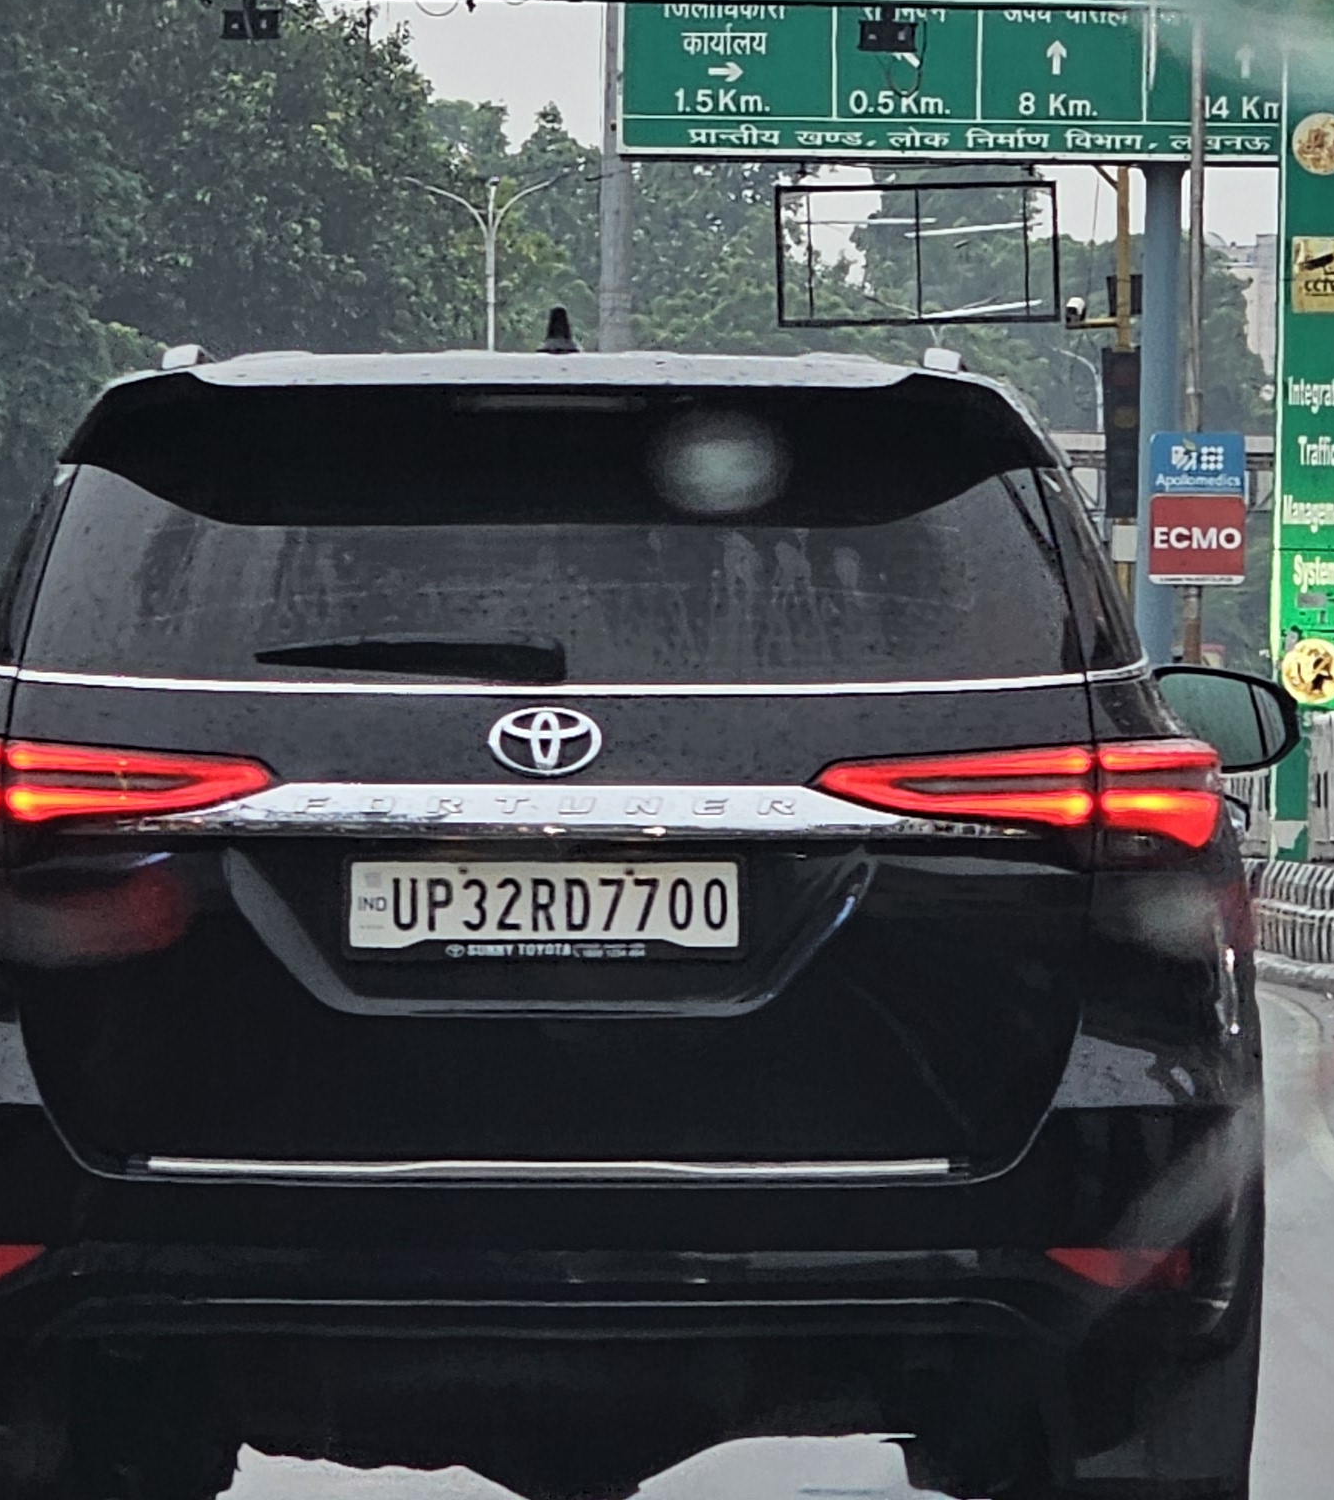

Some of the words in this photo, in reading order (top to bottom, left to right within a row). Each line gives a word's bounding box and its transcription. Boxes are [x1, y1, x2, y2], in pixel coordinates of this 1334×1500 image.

[681, 22, 768, 55] कार्यालय
[1019, 92, 1036, 116] 8
[887, 126, 951, 147] लोक
[966, 126, 1050, 149] निर्माण
[1153, 526, 1242, 550] ECMO
[294, 795, 796, 817] FORTUNER
[392, 877, 728, 932] UP32RD7700
